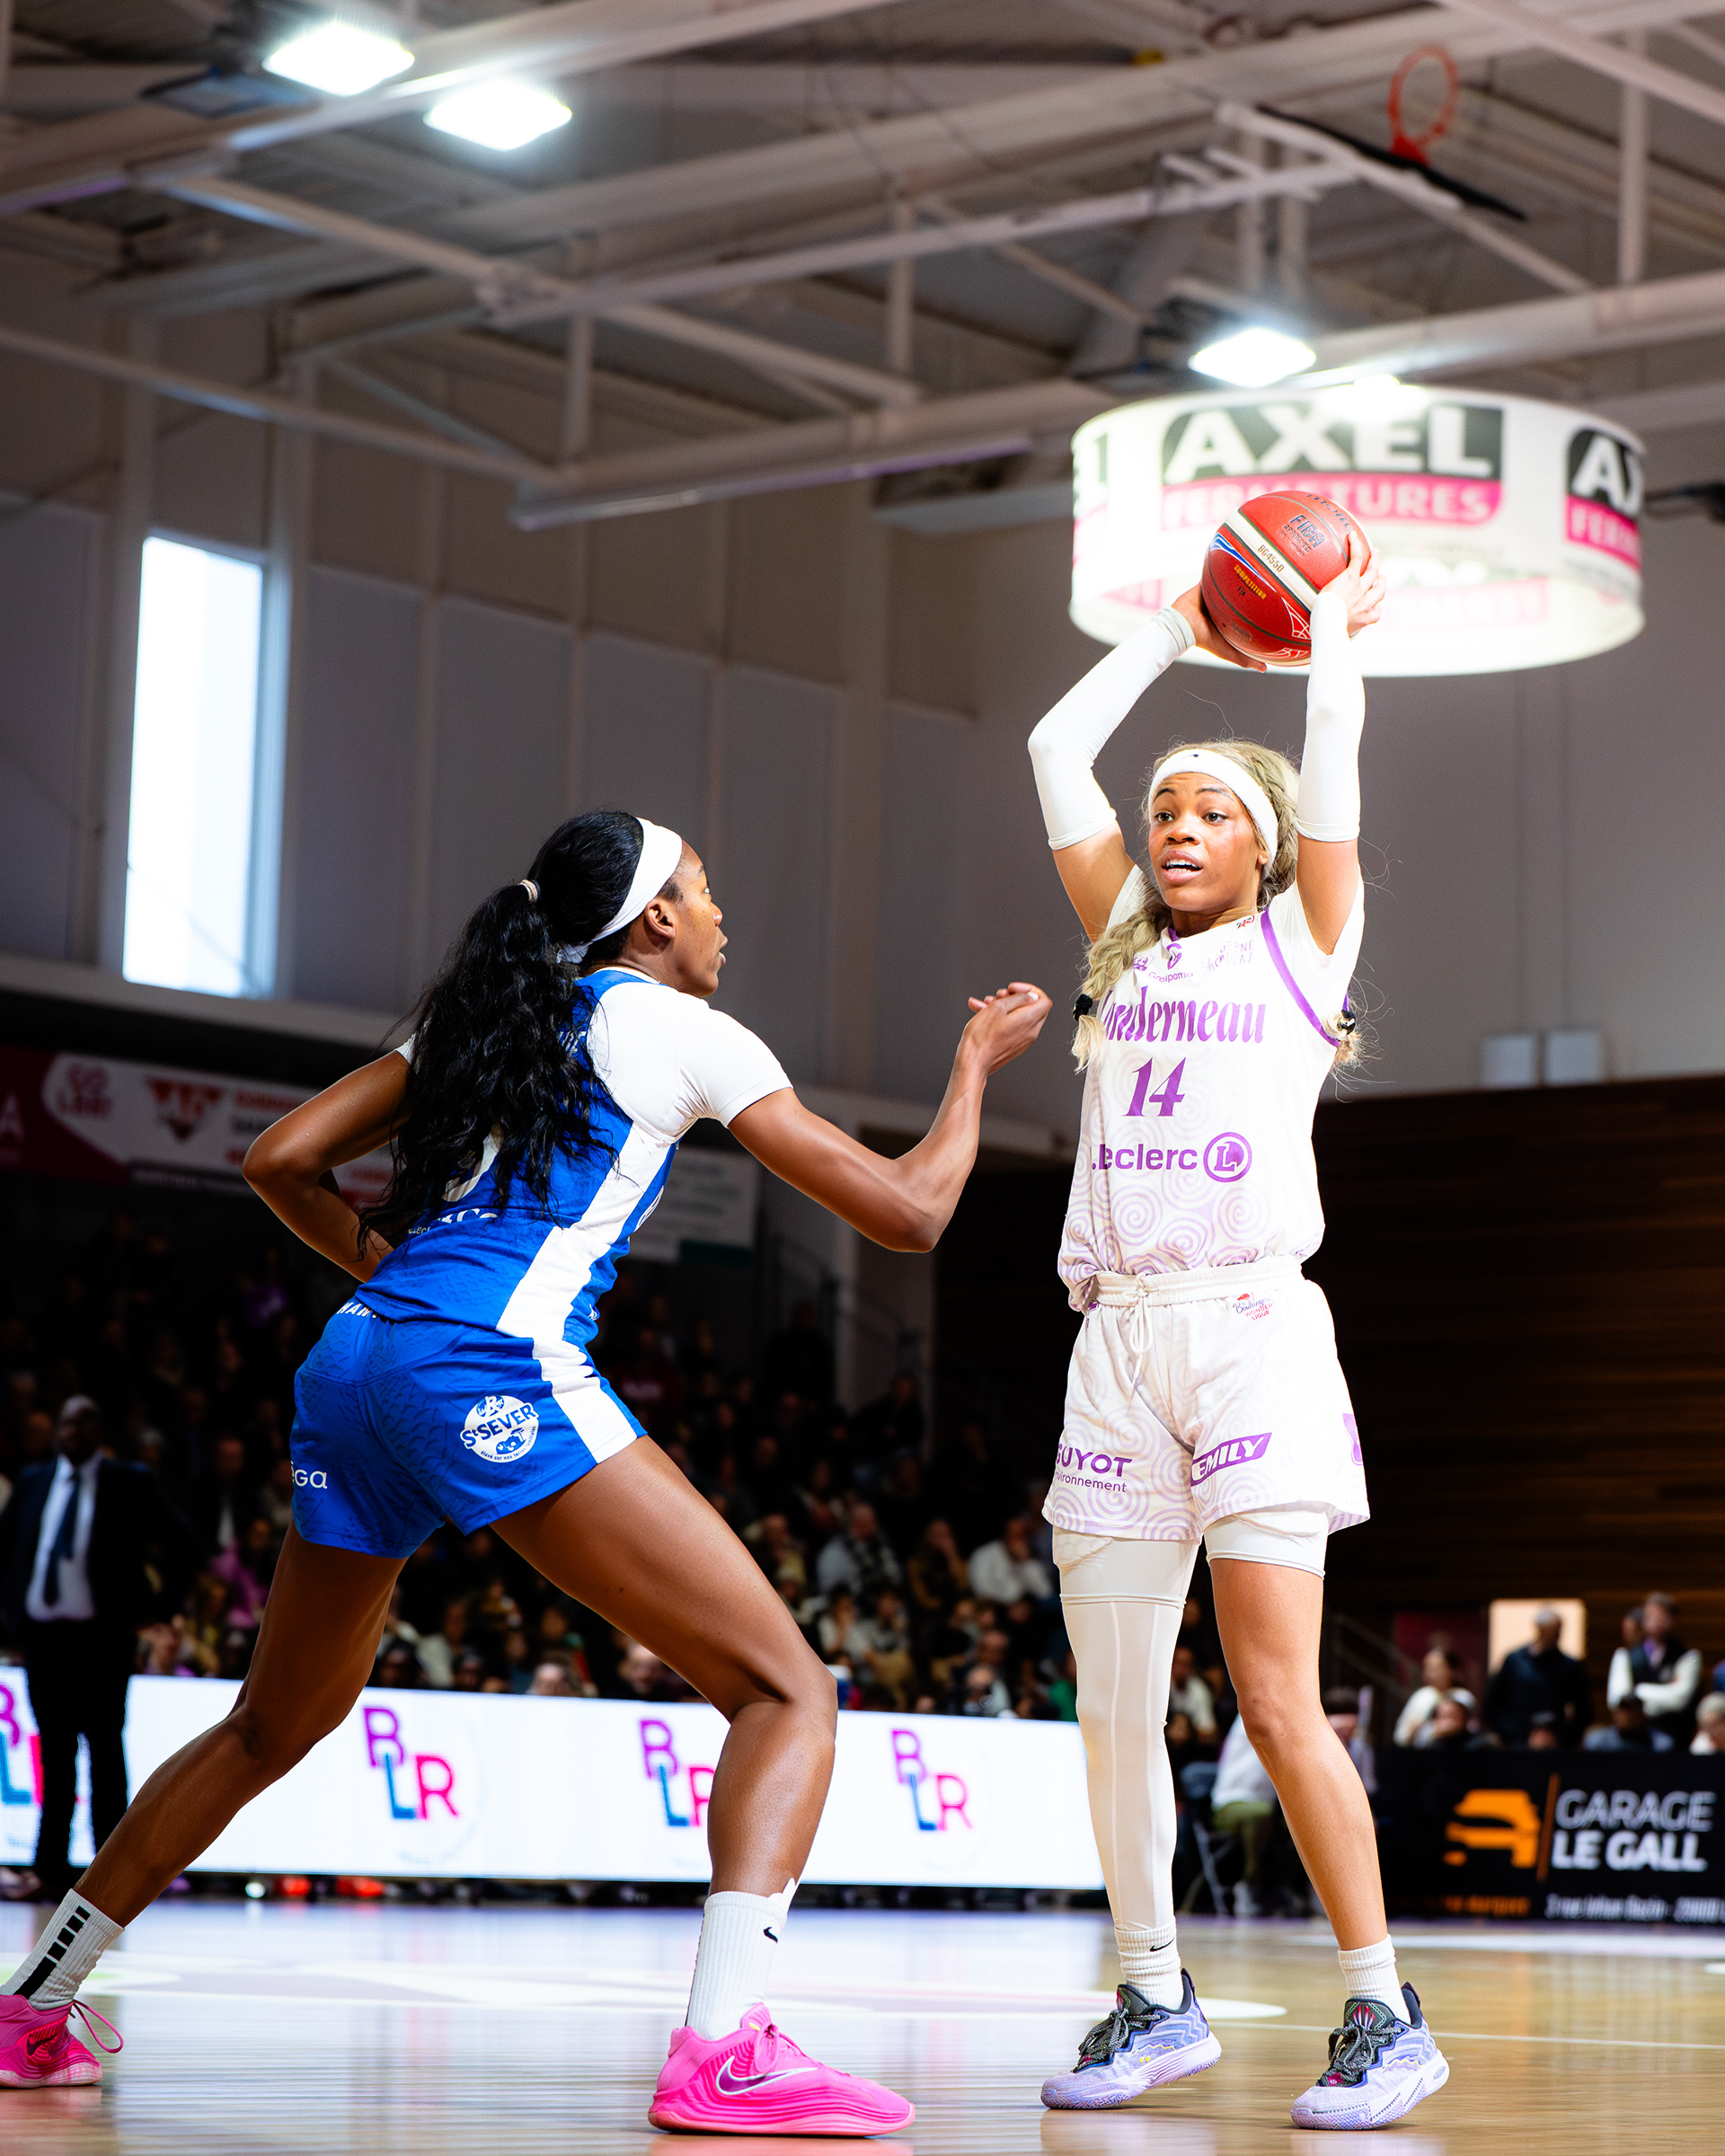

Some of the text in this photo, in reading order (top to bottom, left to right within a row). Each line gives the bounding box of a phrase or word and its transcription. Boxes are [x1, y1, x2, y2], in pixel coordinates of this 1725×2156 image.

[1164, 406, 1491, 485] AXEL
[1163, 481, 1489, 528] FERTURES
[1290, 514, 1325, 547] FIBA
[1258, 544, 1285, 572] BG4550
[1234, 564, 1267, 599] COMPETITION
[1121, 1057, 1186, 1118] 14
[1192, 1436, 1265, 1481] EMILY
[1555, 1789, 1717, 1832] GARAGE
[1552, 1829, 1708, 1873] LE GALL
